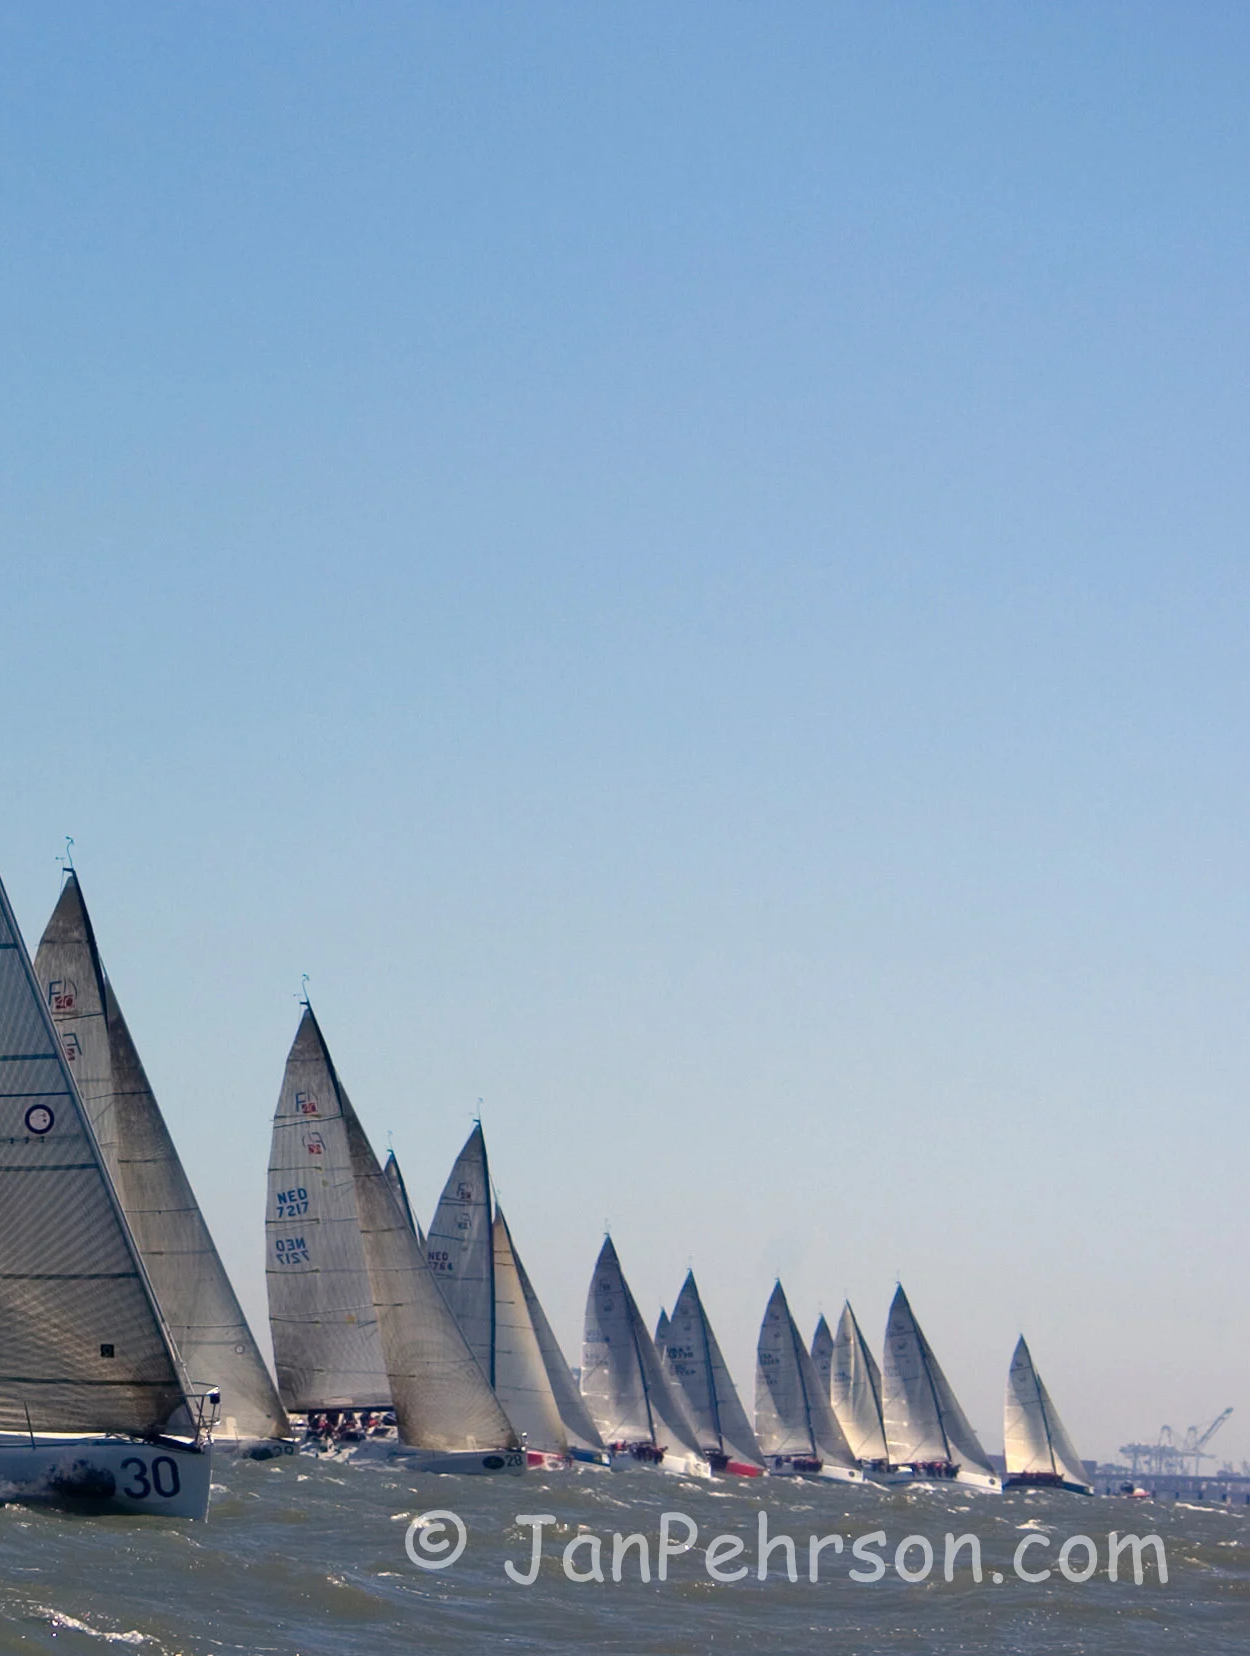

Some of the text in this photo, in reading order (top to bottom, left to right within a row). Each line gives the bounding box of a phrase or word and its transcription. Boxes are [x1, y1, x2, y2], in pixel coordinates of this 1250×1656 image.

[277, 1188, 307, 1204] NED
[276, 1201, 309, 1218] 7217
[119, 1455, 181, 1499] 30
